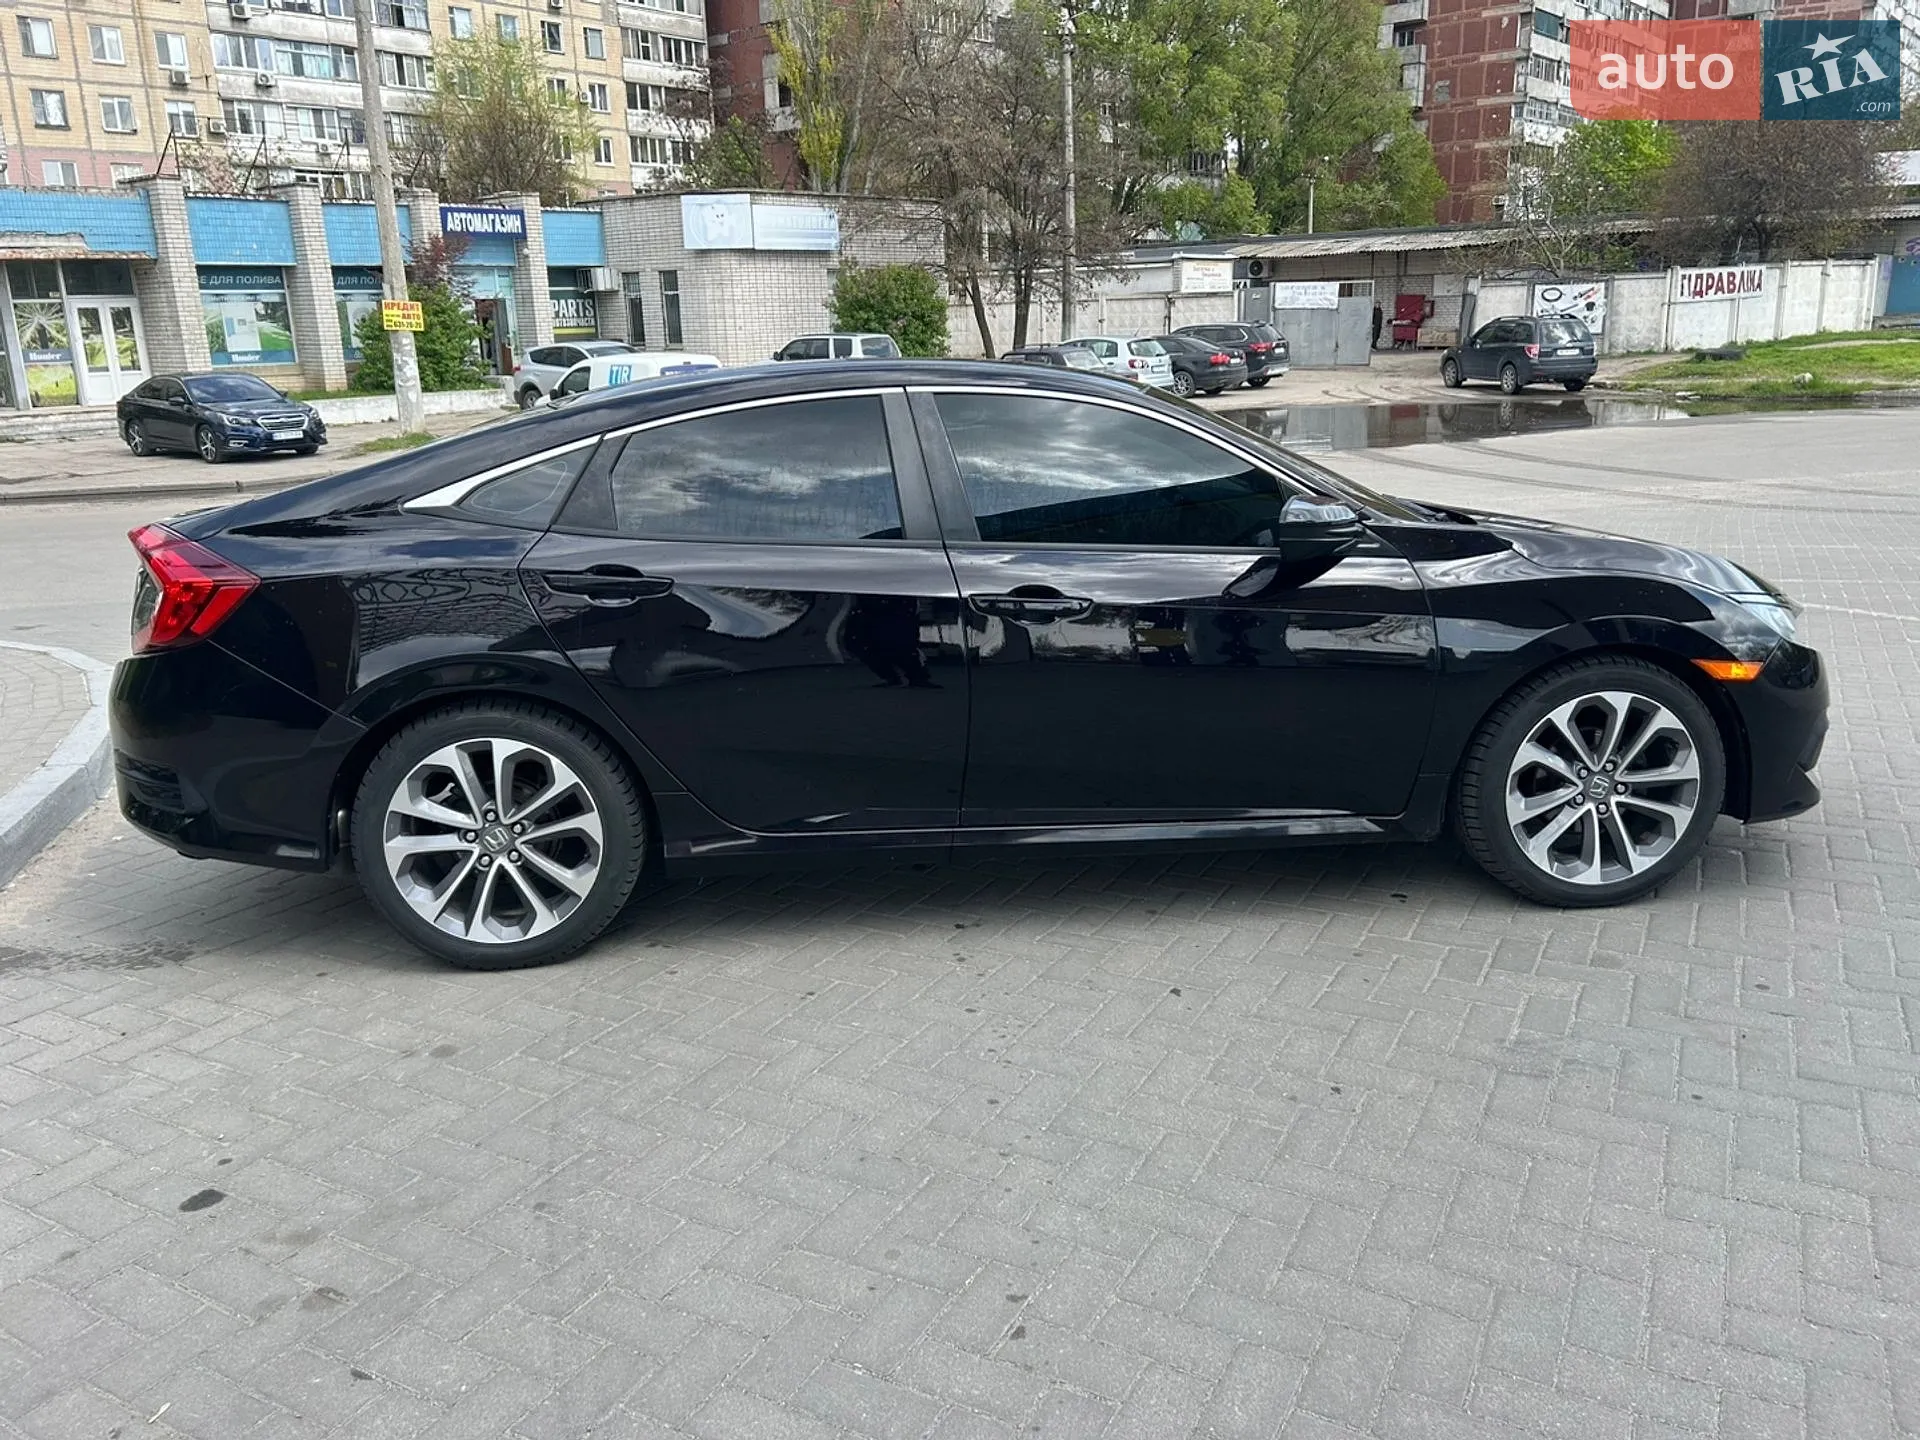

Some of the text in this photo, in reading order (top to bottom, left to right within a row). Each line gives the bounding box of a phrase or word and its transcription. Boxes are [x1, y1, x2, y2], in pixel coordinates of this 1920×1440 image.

[446, 211, 522, 233] АВТОМАГАЗИН
[209, 275, 234, 285] ДЛЯ
[237, 275, 282, 285] ПОЛИВА
[336, 276, 358, 286] ДЛЯ
[1680, 269, 1763, 299] ГІДРАВЛІКА
[550, 298, 594, 318] PARTS
[610, 365, 631, 385] TIR
